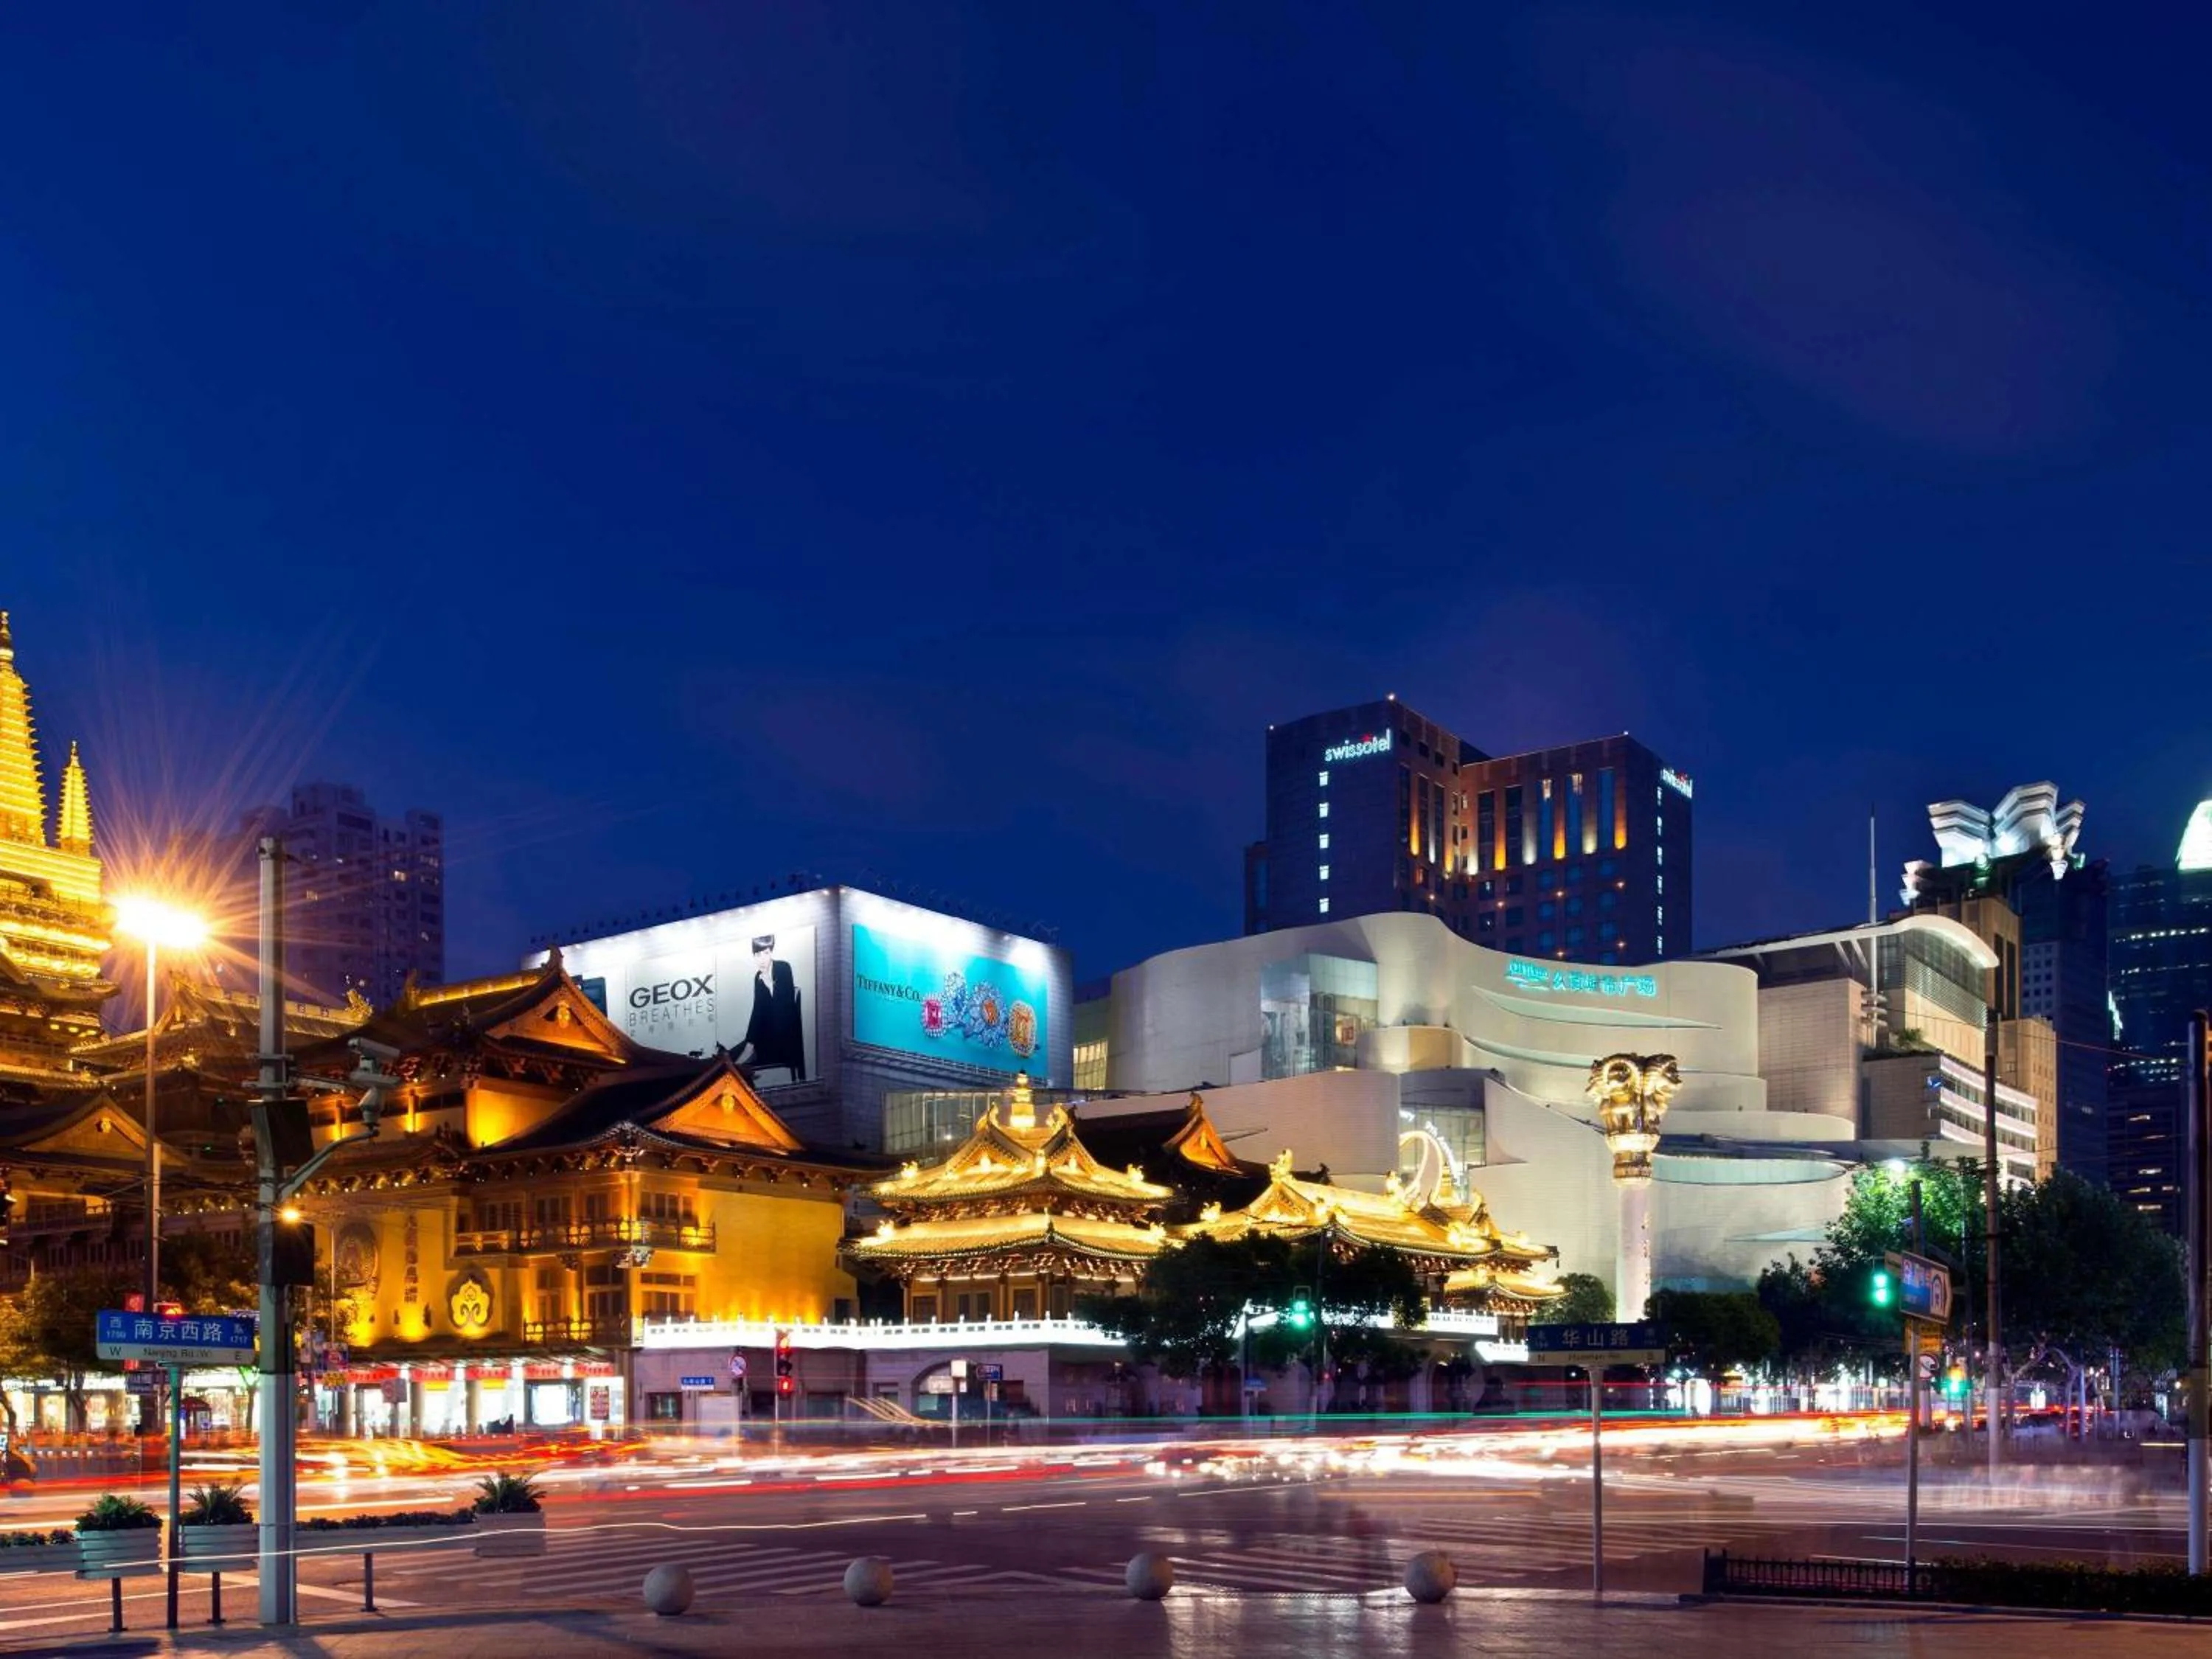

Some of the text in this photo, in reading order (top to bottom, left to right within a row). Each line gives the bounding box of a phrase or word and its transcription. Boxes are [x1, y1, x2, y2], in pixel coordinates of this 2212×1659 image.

[629, 974, 714, 1009] GEOX
[629, 998, 714, 1027] BREATHES
[134, 1318, 223, 1342] 南京西路
[1562, 1328, 1629, 1348] 华山路
[110, 1346, 122, 1356] W
[234, 1350, 243, 1360] E
